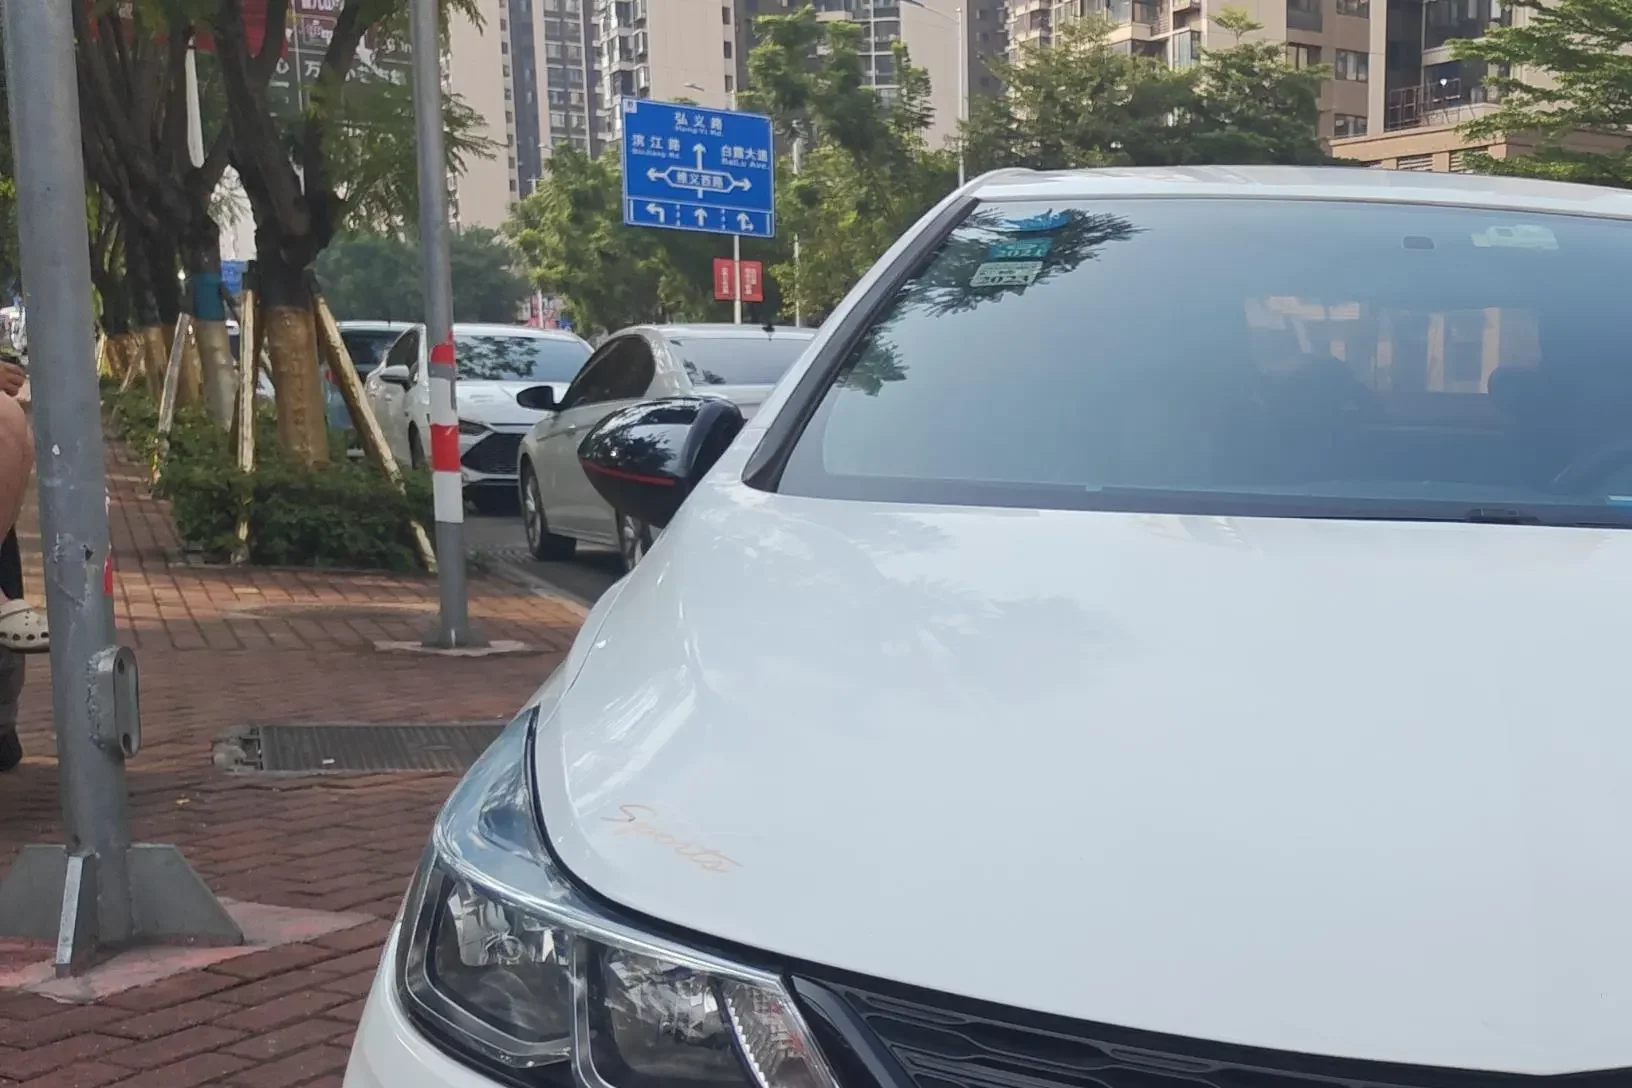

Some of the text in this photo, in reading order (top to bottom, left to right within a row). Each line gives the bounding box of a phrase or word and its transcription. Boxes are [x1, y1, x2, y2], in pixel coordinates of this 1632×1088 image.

[632, 134, 680, 151] 滨江路
[600, 804, 744, 873] Sports
